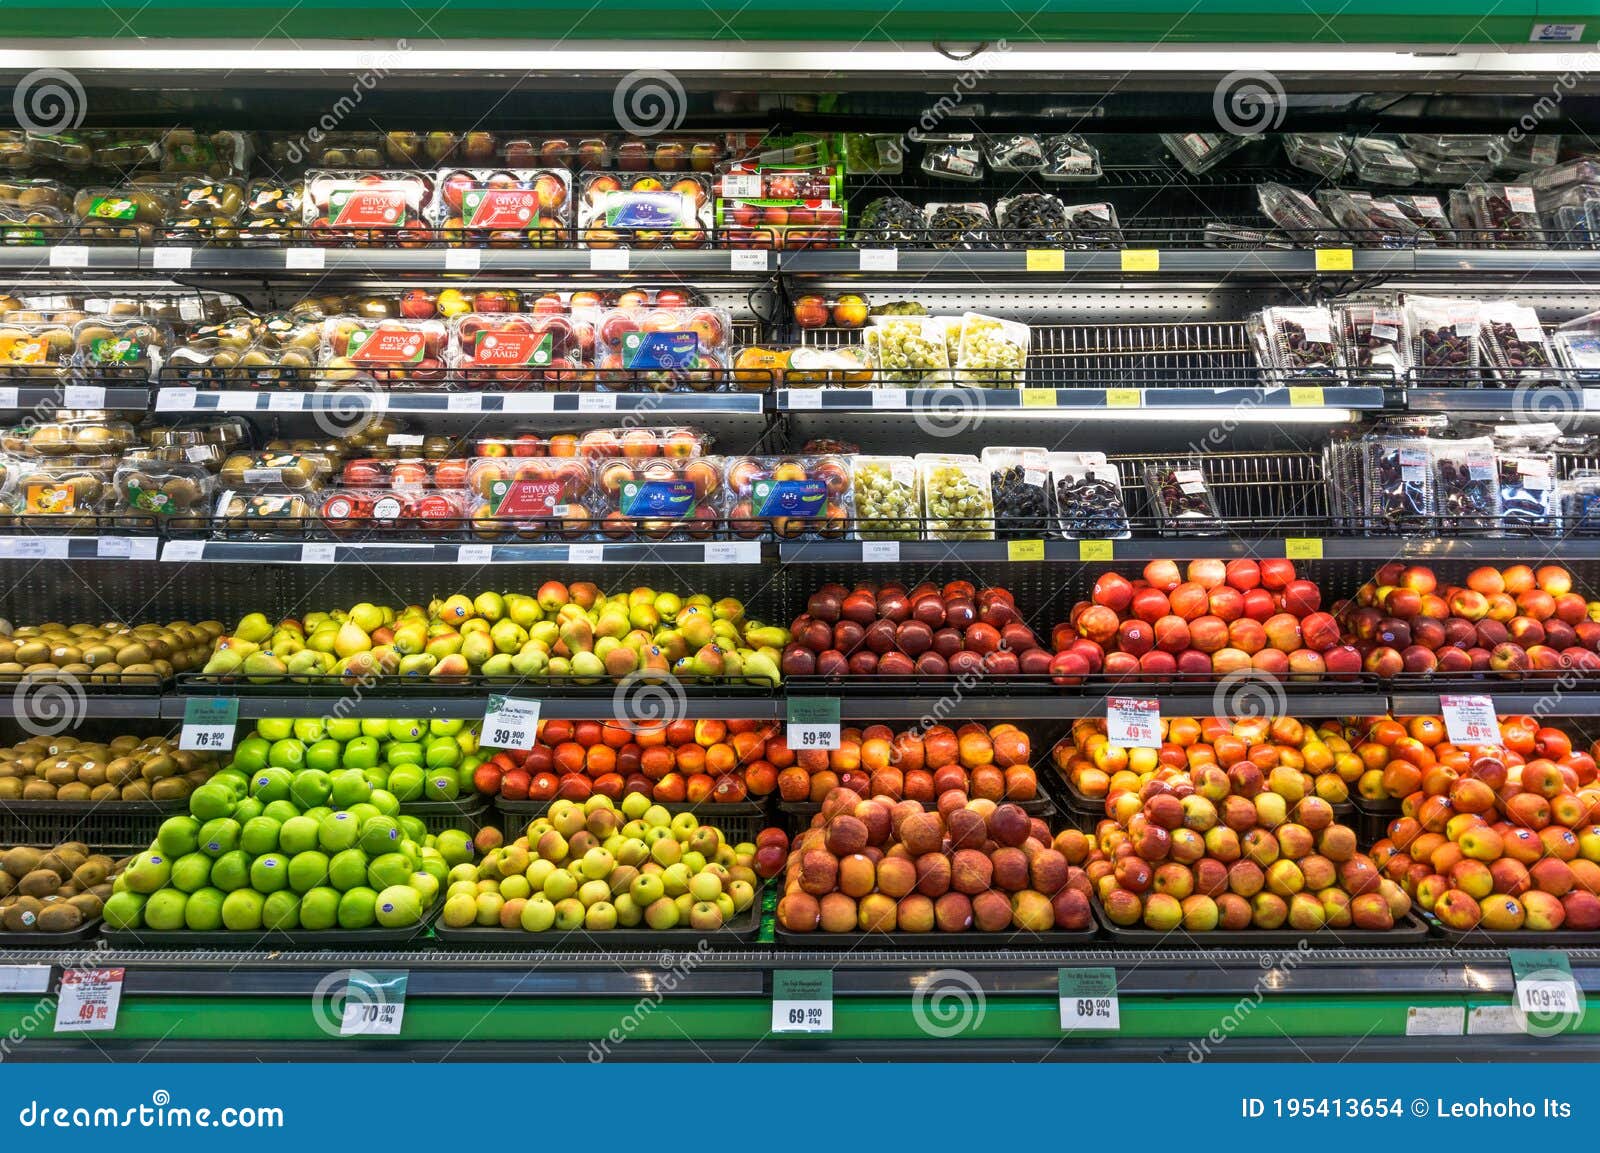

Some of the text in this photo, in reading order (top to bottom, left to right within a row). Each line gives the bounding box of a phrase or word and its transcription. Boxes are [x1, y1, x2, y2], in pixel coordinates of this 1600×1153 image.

[362, 195, 388, 207] envy
[495, 195, 521, 207] envy
[383, 335, 407, 346] envy
[522, 483, 548, 495] envy
[493, 729, 510, 744] 39
[802, 731, 816, 745] 59
[1126, 726, 1139, 738] 49
[1466, 725, 1479, 737] 49
[196, 732, 209, 746] 76
[1526, 989, 1551, 1007] 109
[79, 1004, 95, 1020] 49
[362, 1004, 379, 1022] 70
[1077, 999, 1094, 1017] 69
[789, 1008, 805, 1024] 69
